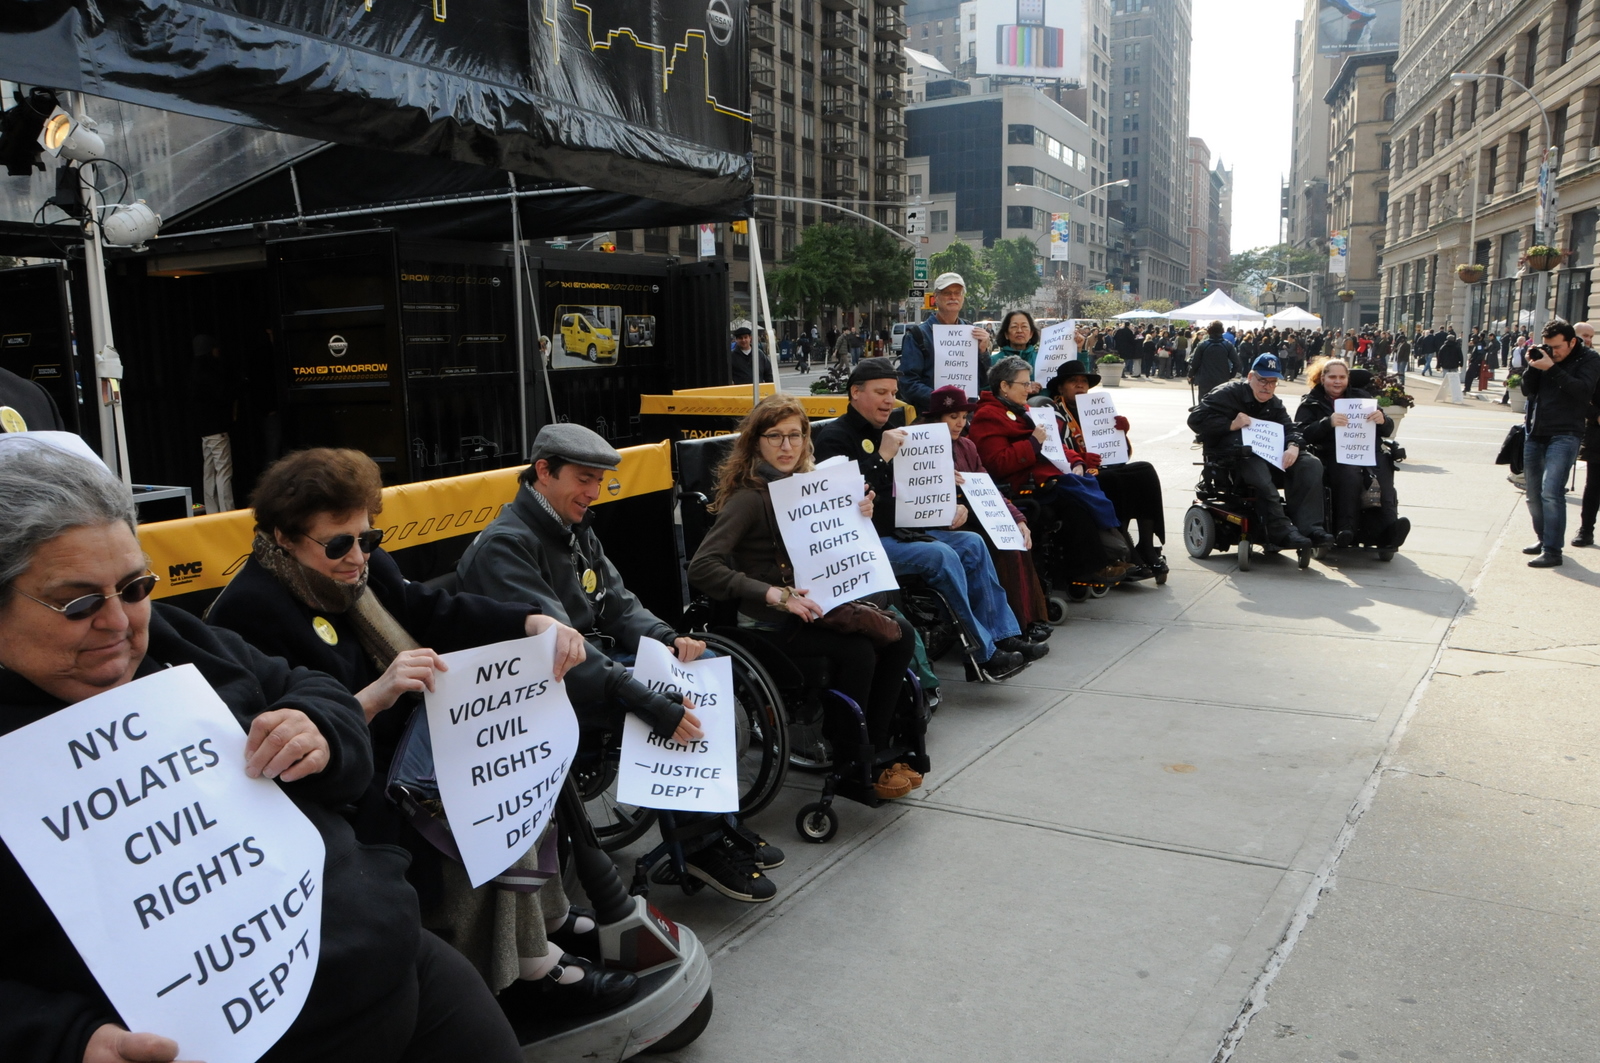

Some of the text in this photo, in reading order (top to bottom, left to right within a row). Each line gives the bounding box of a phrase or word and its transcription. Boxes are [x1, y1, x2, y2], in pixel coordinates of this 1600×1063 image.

[708, 14, 732, 27] NISSAN
[1044, 334, 1072, 345] VIOLATES
[329, 363, 387, 373] TOMORROW
[1084, 407, 1114, 416] VIOLATES
[681, 430, 712, 440] TAXI
[912, 432, 929, 441] NYC
[1092, 428, 1114, 437] RIGHTS
[1248, 428, 1278, 437] VIOLATES
[1255, 434, 1271, 442] CIVIL
[901, 445, 944, 456] VIOLATES
[1252, 440, 1274, 451] RIGHTS
[913, 461, 936, 471] CIVIL
[801, 479, 829, 496] NYC
[909, 475, 943, 486] RIGHTS
[788, 494, 852, 522] VIOLATES
[914, 509, 943, 519] DEP'T
[810, 517, 844, 534] CIVIL
[809, 530, 859, 556] RIGHTS
[169, 561, 202, 577] NYC
[832, 572, 870, 598] DEP'T
[475, 657, 521, 684] NYC
[671, 664, 694, 683] NYC
[648, 679, 717, 707] VIOATES
[449, 680, 549, 725] VIOLATES
[68, 712, 148, 769] NYC
[476, 716, 528, 748] CIVIL
[471, 741, 552, 786] RIGHTS
[42, 738, 220, 842] VIOLATES
[651, 784, 704, 798] DEP'T
[506, 792, 556, 849] DEP'T
[125, 801, 217, 865] CIVIL
[133, 836, 265, 930] RIGHTS
[222, 929, 311, 1034] DEP'T
